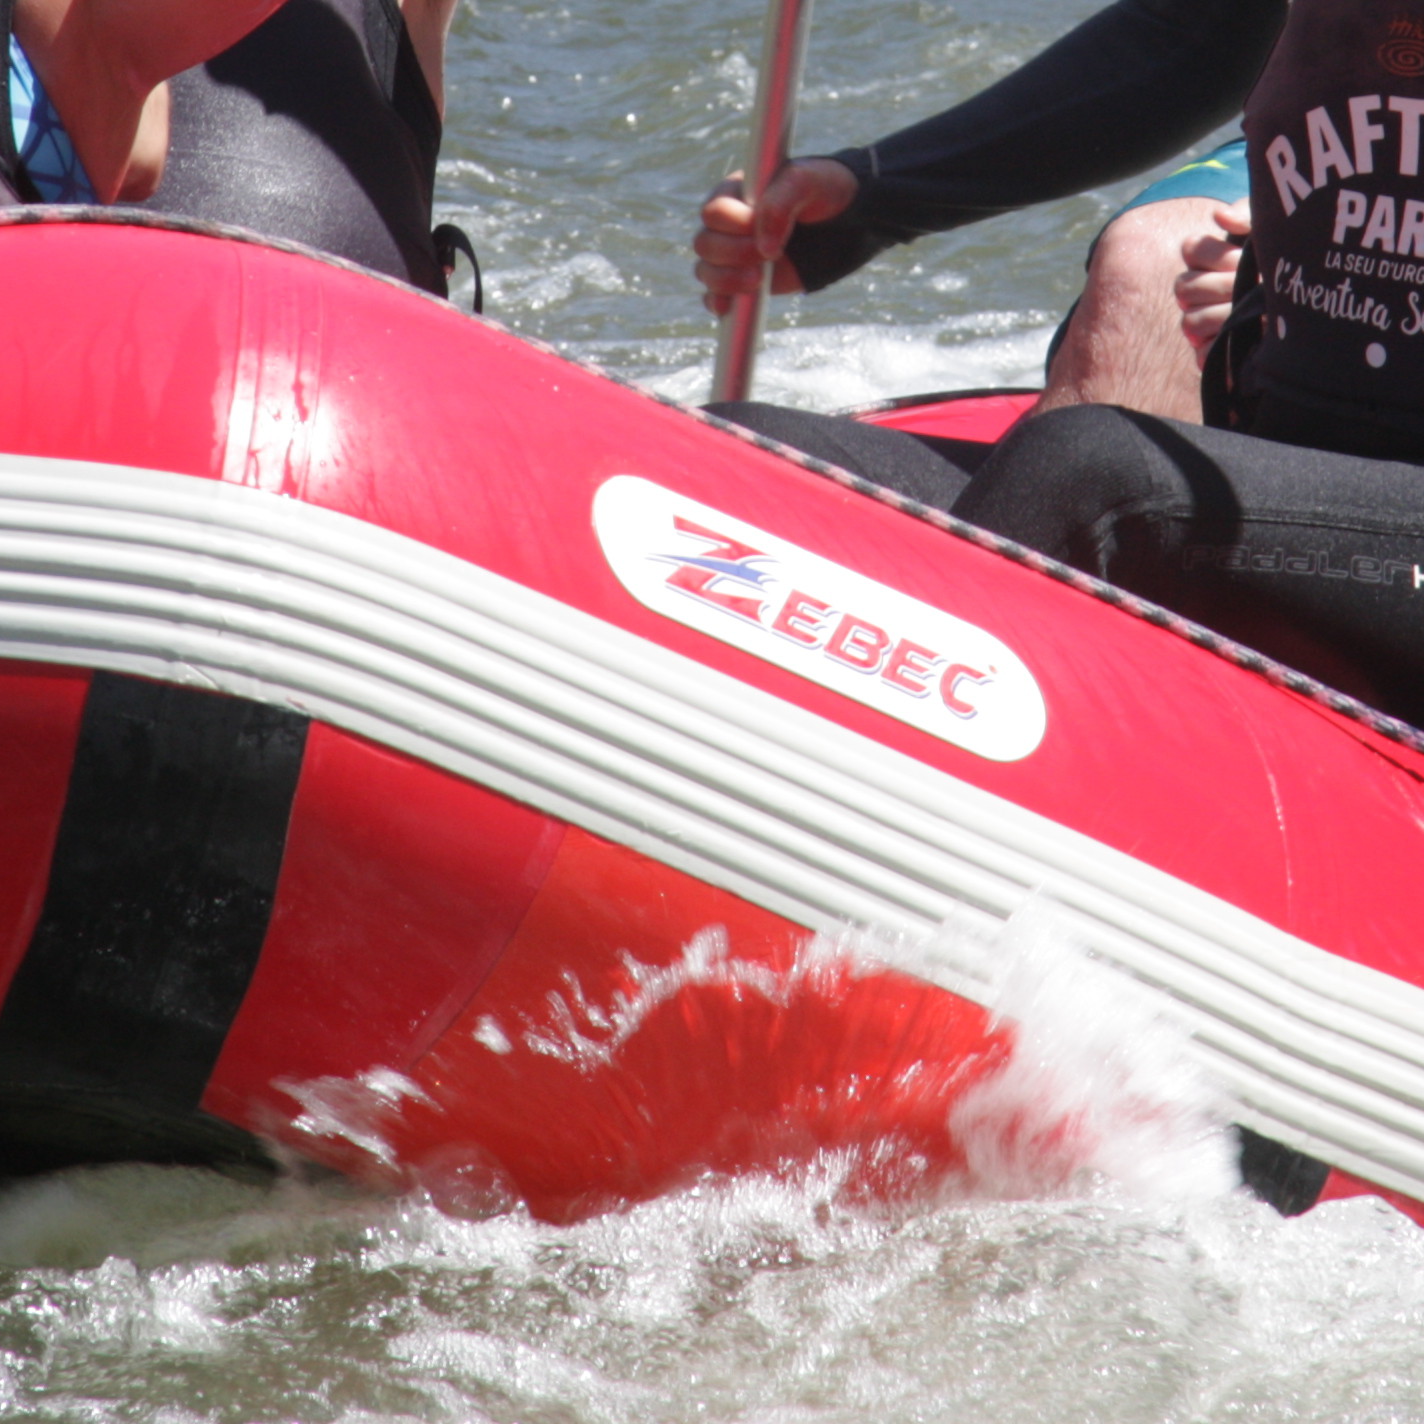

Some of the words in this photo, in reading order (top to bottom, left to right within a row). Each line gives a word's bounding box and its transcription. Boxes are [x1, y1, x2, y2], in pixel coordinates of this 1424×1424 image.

[1325, 250, 1342, 270] LA
[1344, 253, 1376, 276] SEU
[662, 514, 995, 720] ZEBEC
